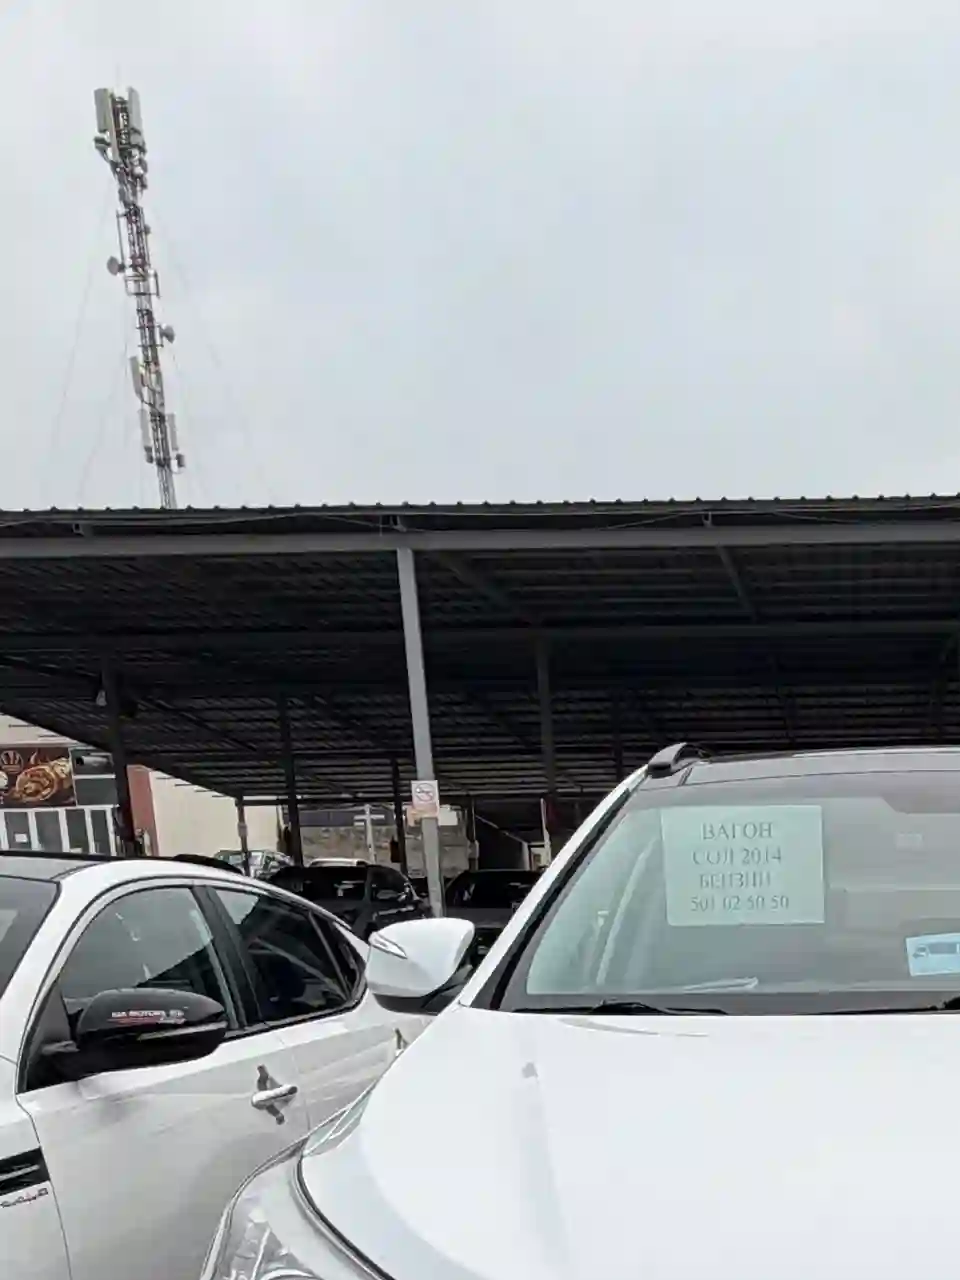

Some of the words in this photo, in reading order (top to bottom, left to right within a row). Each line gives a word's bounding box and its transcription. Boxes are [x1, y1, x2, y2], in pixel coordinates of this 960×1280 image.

[742, 846, 782, 865] 2014
[690, 895, 715, 912] 501
[747, 895, 765, 911] 50
[771, 895, 789, 911] 50
